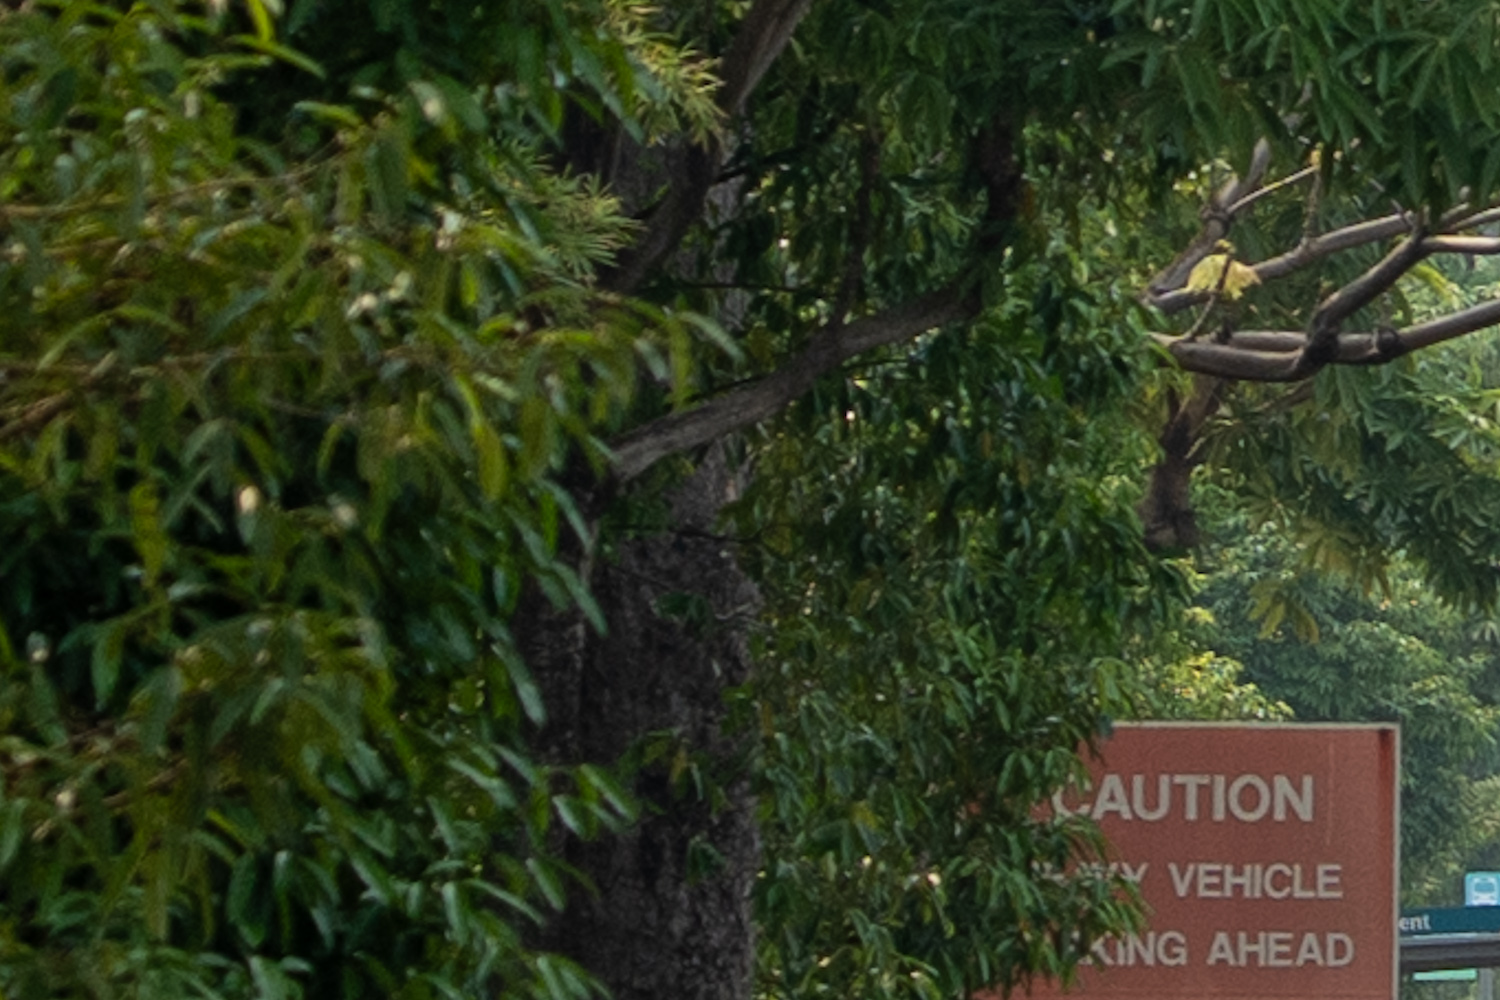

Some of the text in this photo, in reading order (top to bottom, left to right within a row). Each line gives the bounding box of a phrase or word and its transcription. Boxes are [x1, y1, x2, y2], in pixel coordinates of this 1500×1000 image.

[1052, 773, 1314, 822] CAUTION
[1168, 862, 1344, 899] VEHICLE
[1068, 929, 1355, 968] KING AHEAD
